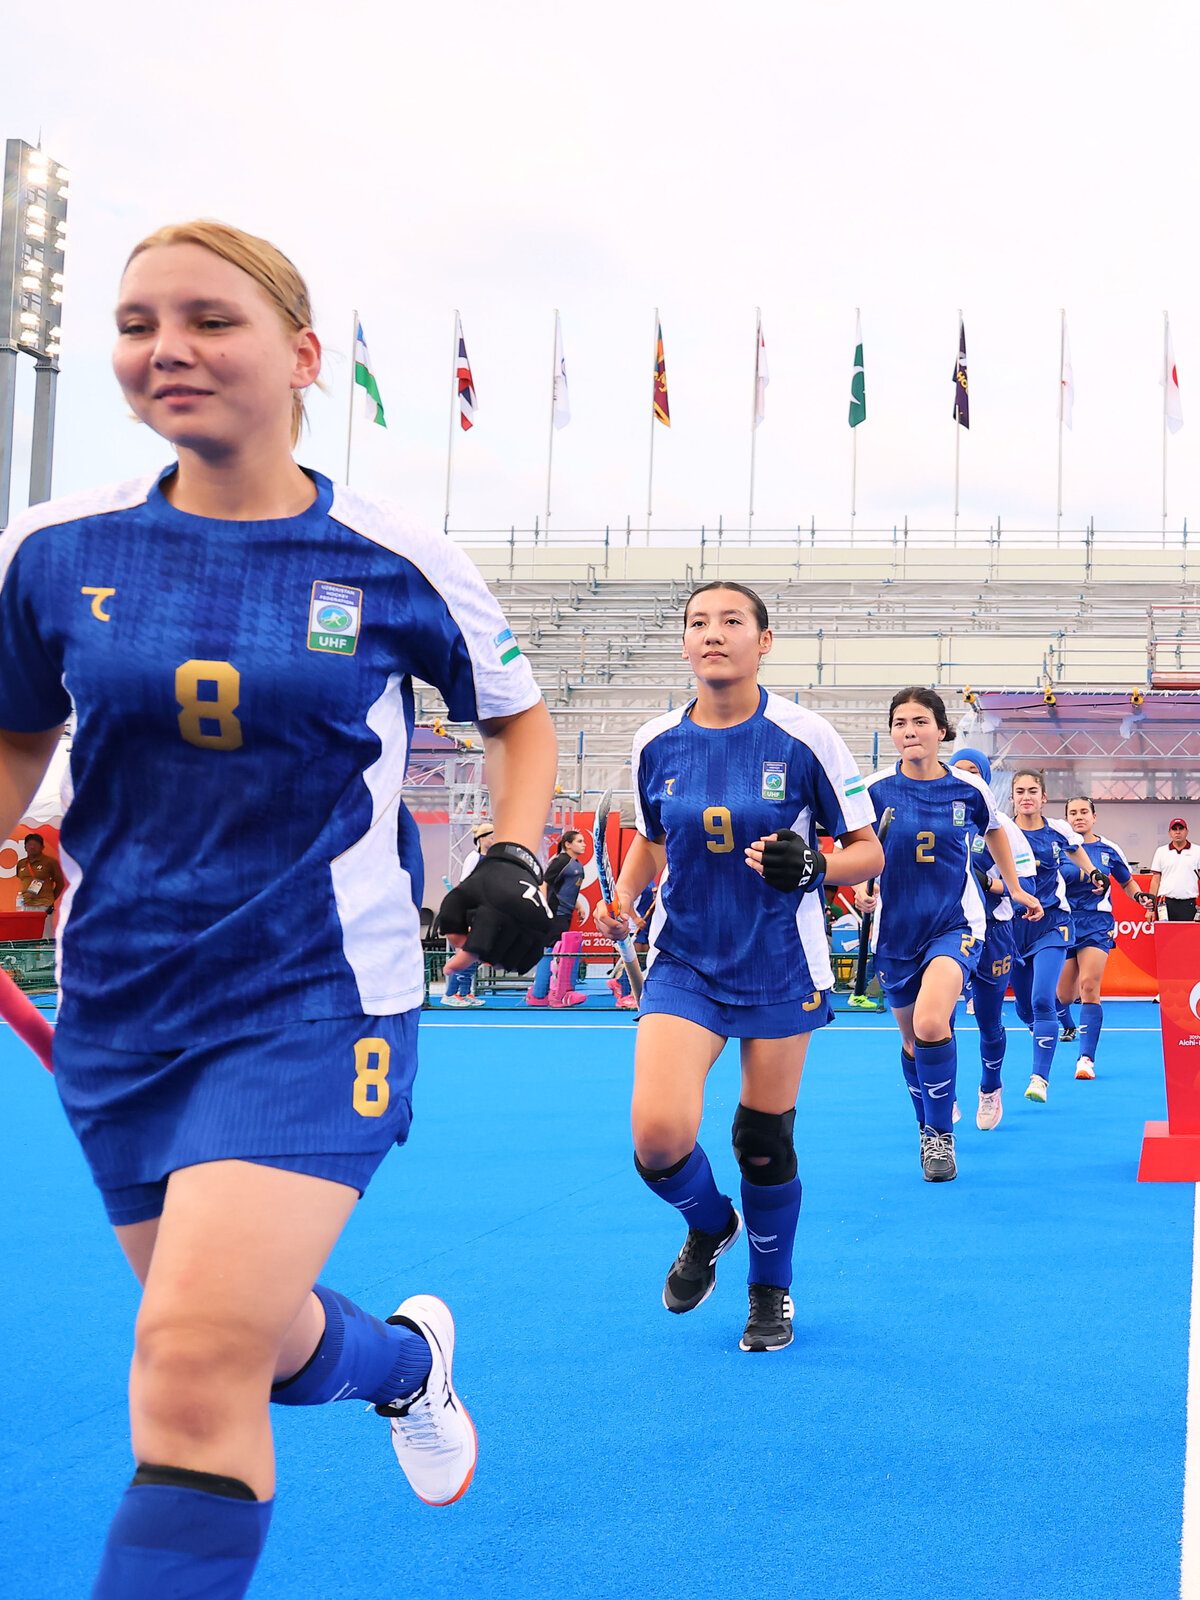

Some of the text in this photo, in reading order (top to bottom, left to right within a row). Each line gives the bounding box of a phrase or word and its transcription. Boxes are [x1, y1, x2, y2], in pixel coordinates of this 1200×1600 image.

[319, 636, 347, 649] UHF
[175, 659, 243, 751] 8
[702, 806, 734, 853] 9
[916, 831, 936, 863] 2
[960, 933, 976, 957] 2
[1058, 926, 1069, 942] 7
[992, 955, 1012, 977] 66
[352, 1037, 391, 1117] 8
